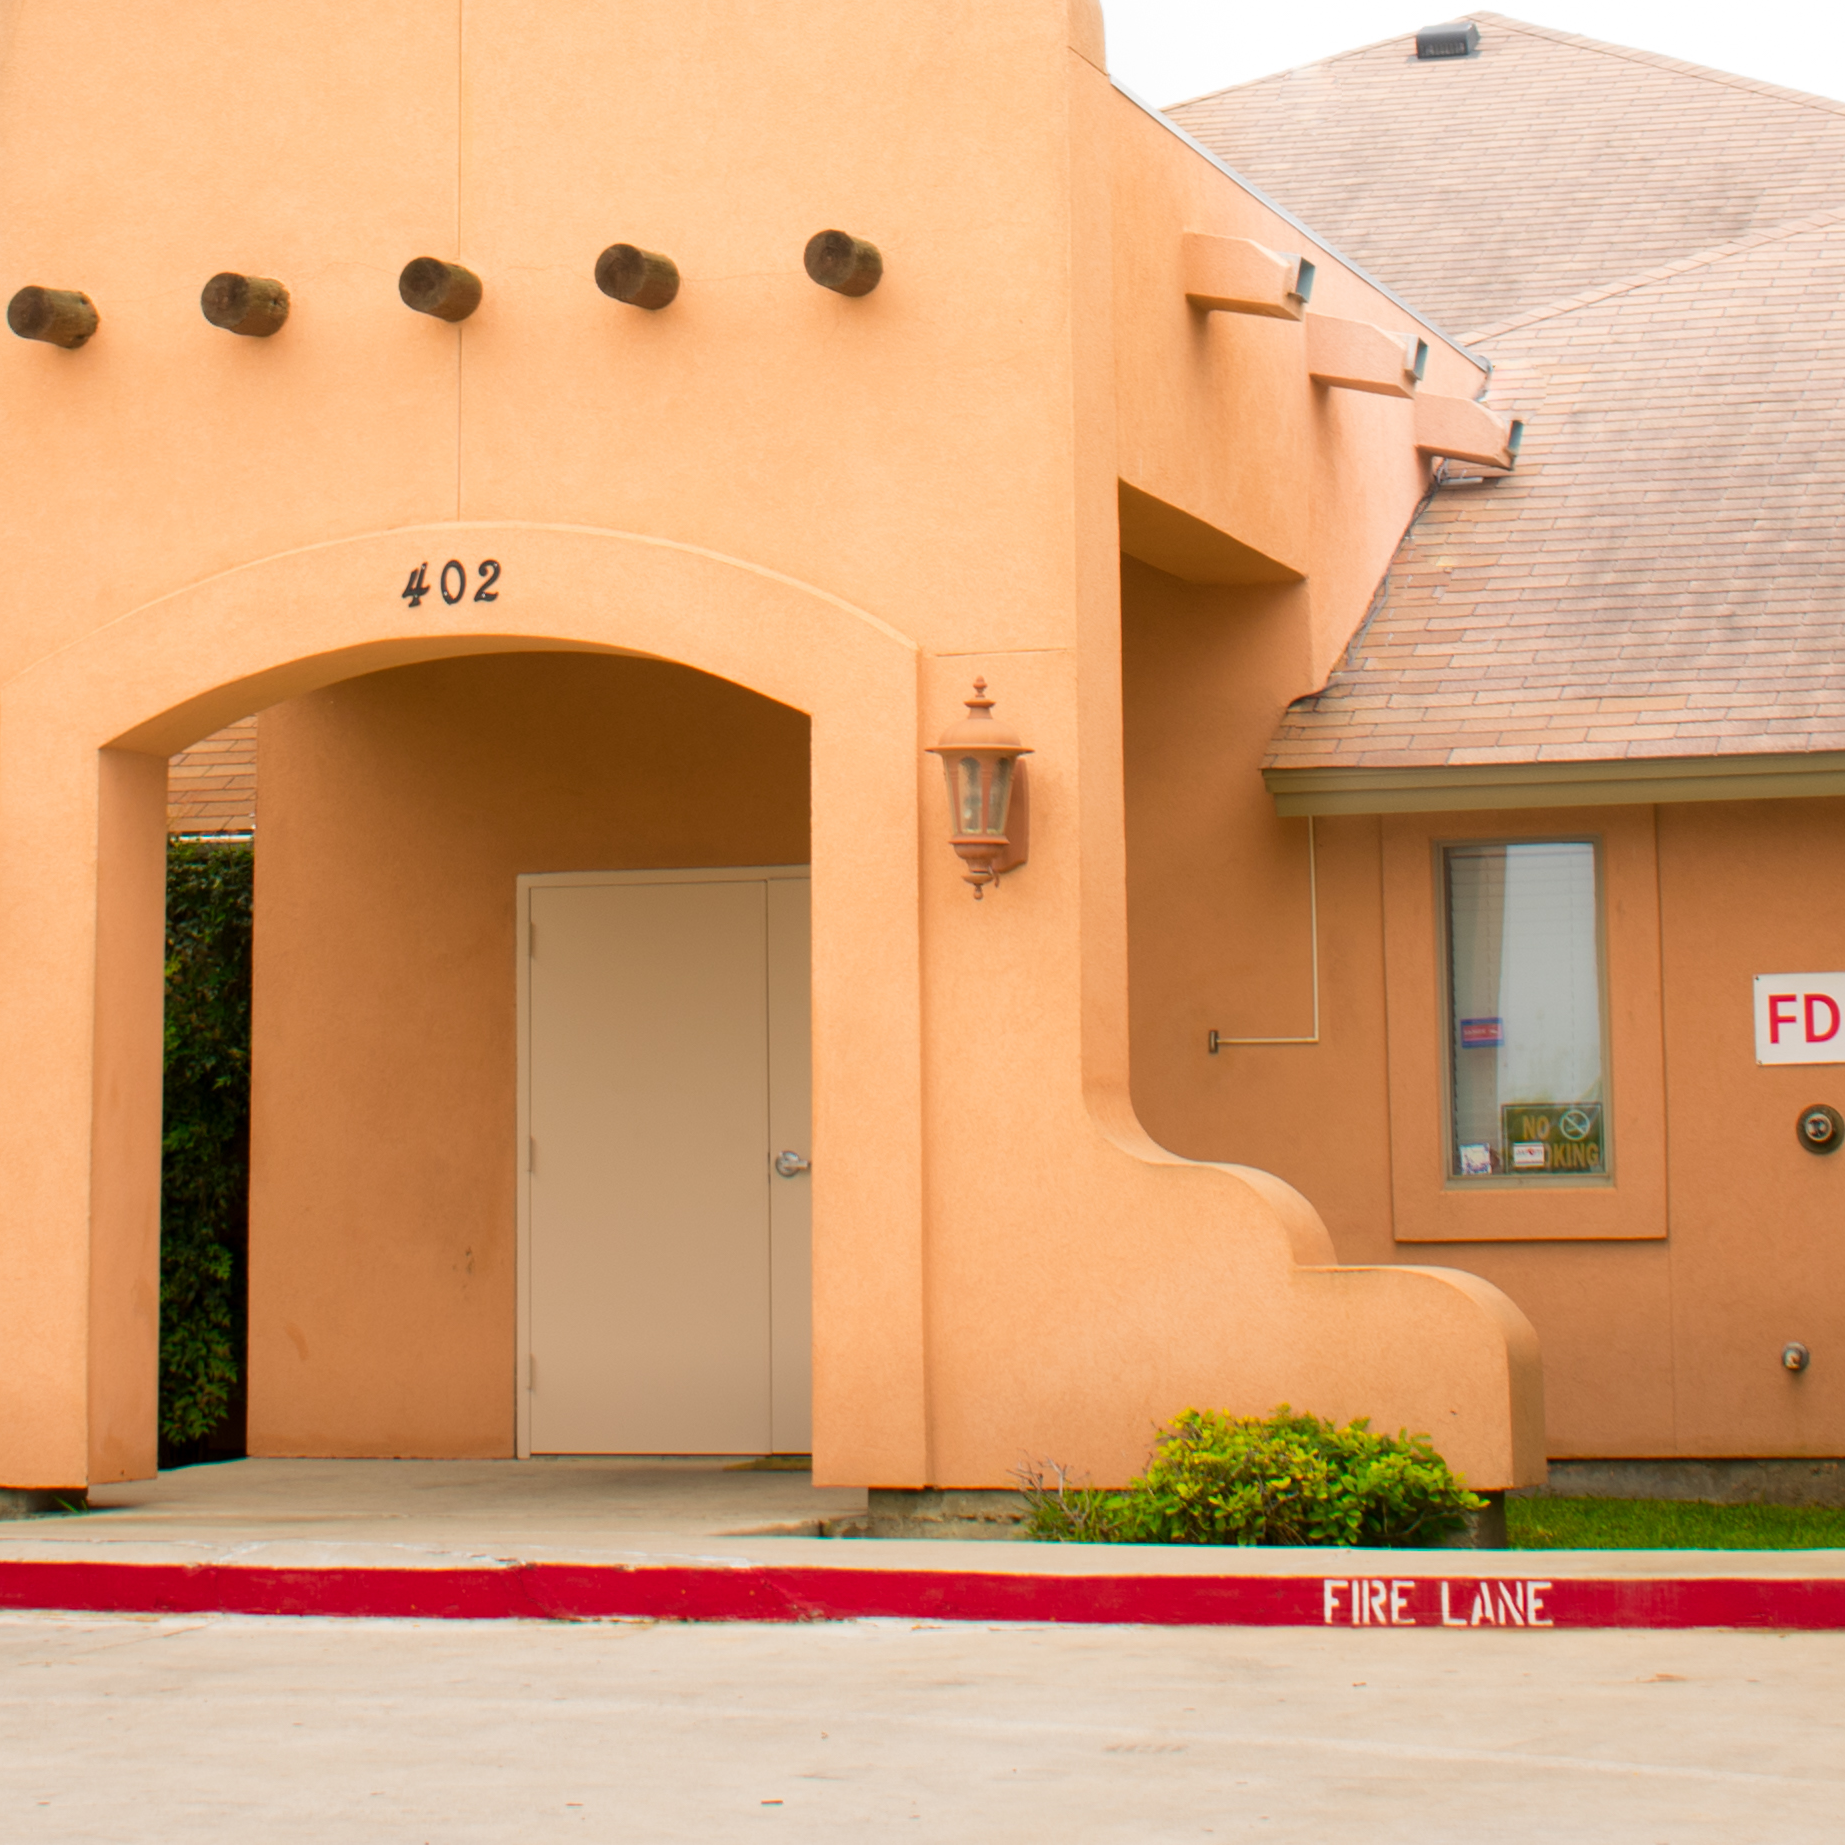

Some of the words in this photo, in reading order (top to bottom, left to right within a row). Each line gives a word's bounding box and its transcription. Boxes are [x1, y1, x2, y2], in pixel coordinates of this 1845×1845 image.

[402, 559, 501, 607] 402
[1522, 1115, 1550, 1140] NO
[1528, 1142, 1600, 1169] OKING
[1323, 1579, 1416, 1624] FIRE
[1440, 1580, 1553, 1626] LANE
